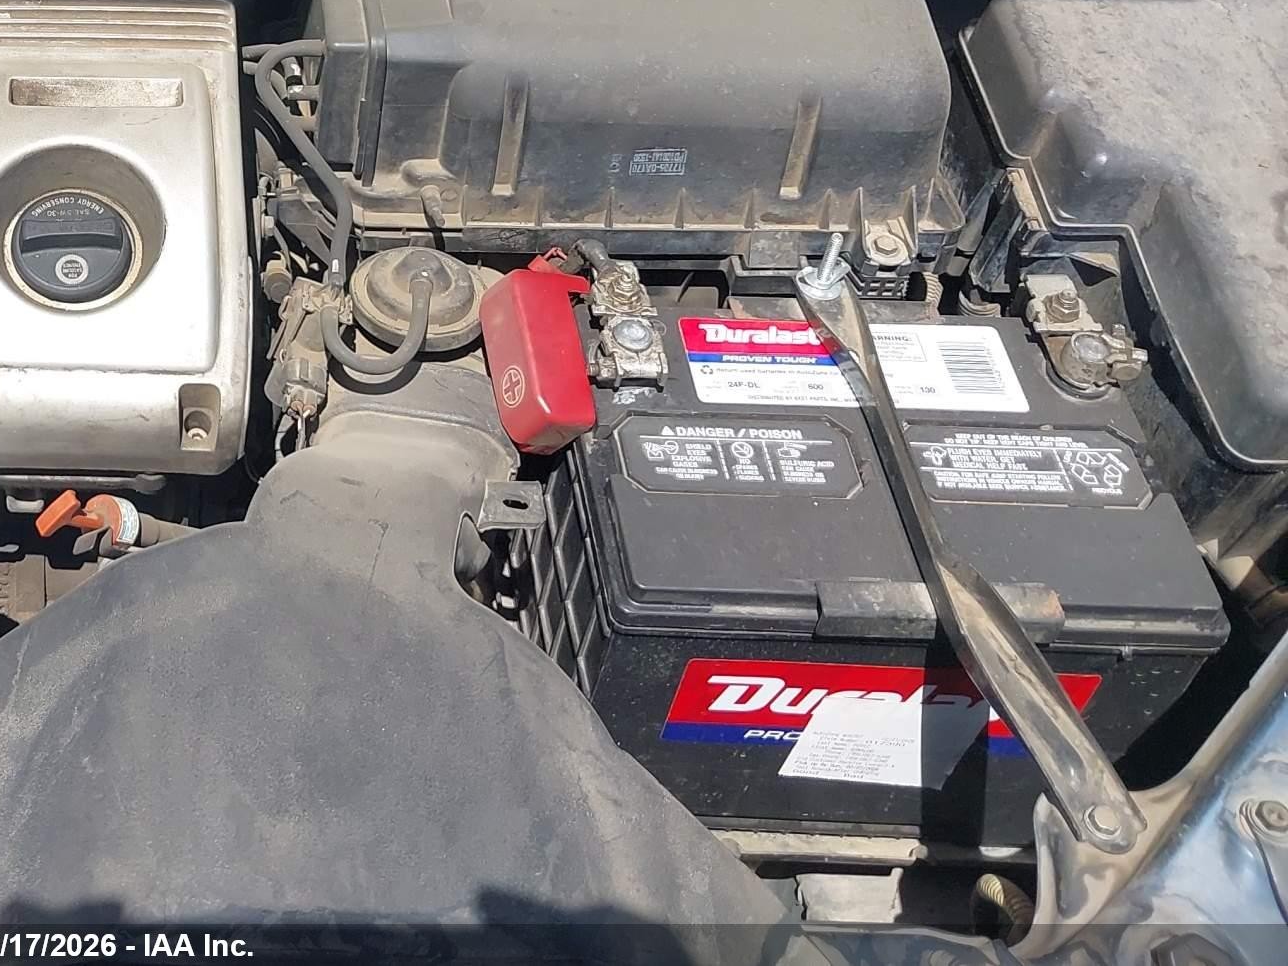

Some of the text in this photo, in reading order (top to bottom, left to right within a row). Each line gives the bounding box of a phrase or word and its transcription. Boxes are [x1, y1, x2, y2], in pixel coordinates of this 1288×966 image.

[31, 196, 105, 217] ENERGY CONSERVING
[698, 323, 821, 345] Duralast
[722, 355, 817, 364] PROVEN TOUGH
[727, 381, 761, 389] 24F-DL
[675, 426, 737, 438] DANGER
[749, 428, 803, 440] POISON
[946, 447, 1042, 458] FLUSH EYES IMMEDIATELY
[952, 461, 985, 469] MEDICAL
[986, 462, 1006, 470] HELP
[744, 729, 803, 741] PRO
